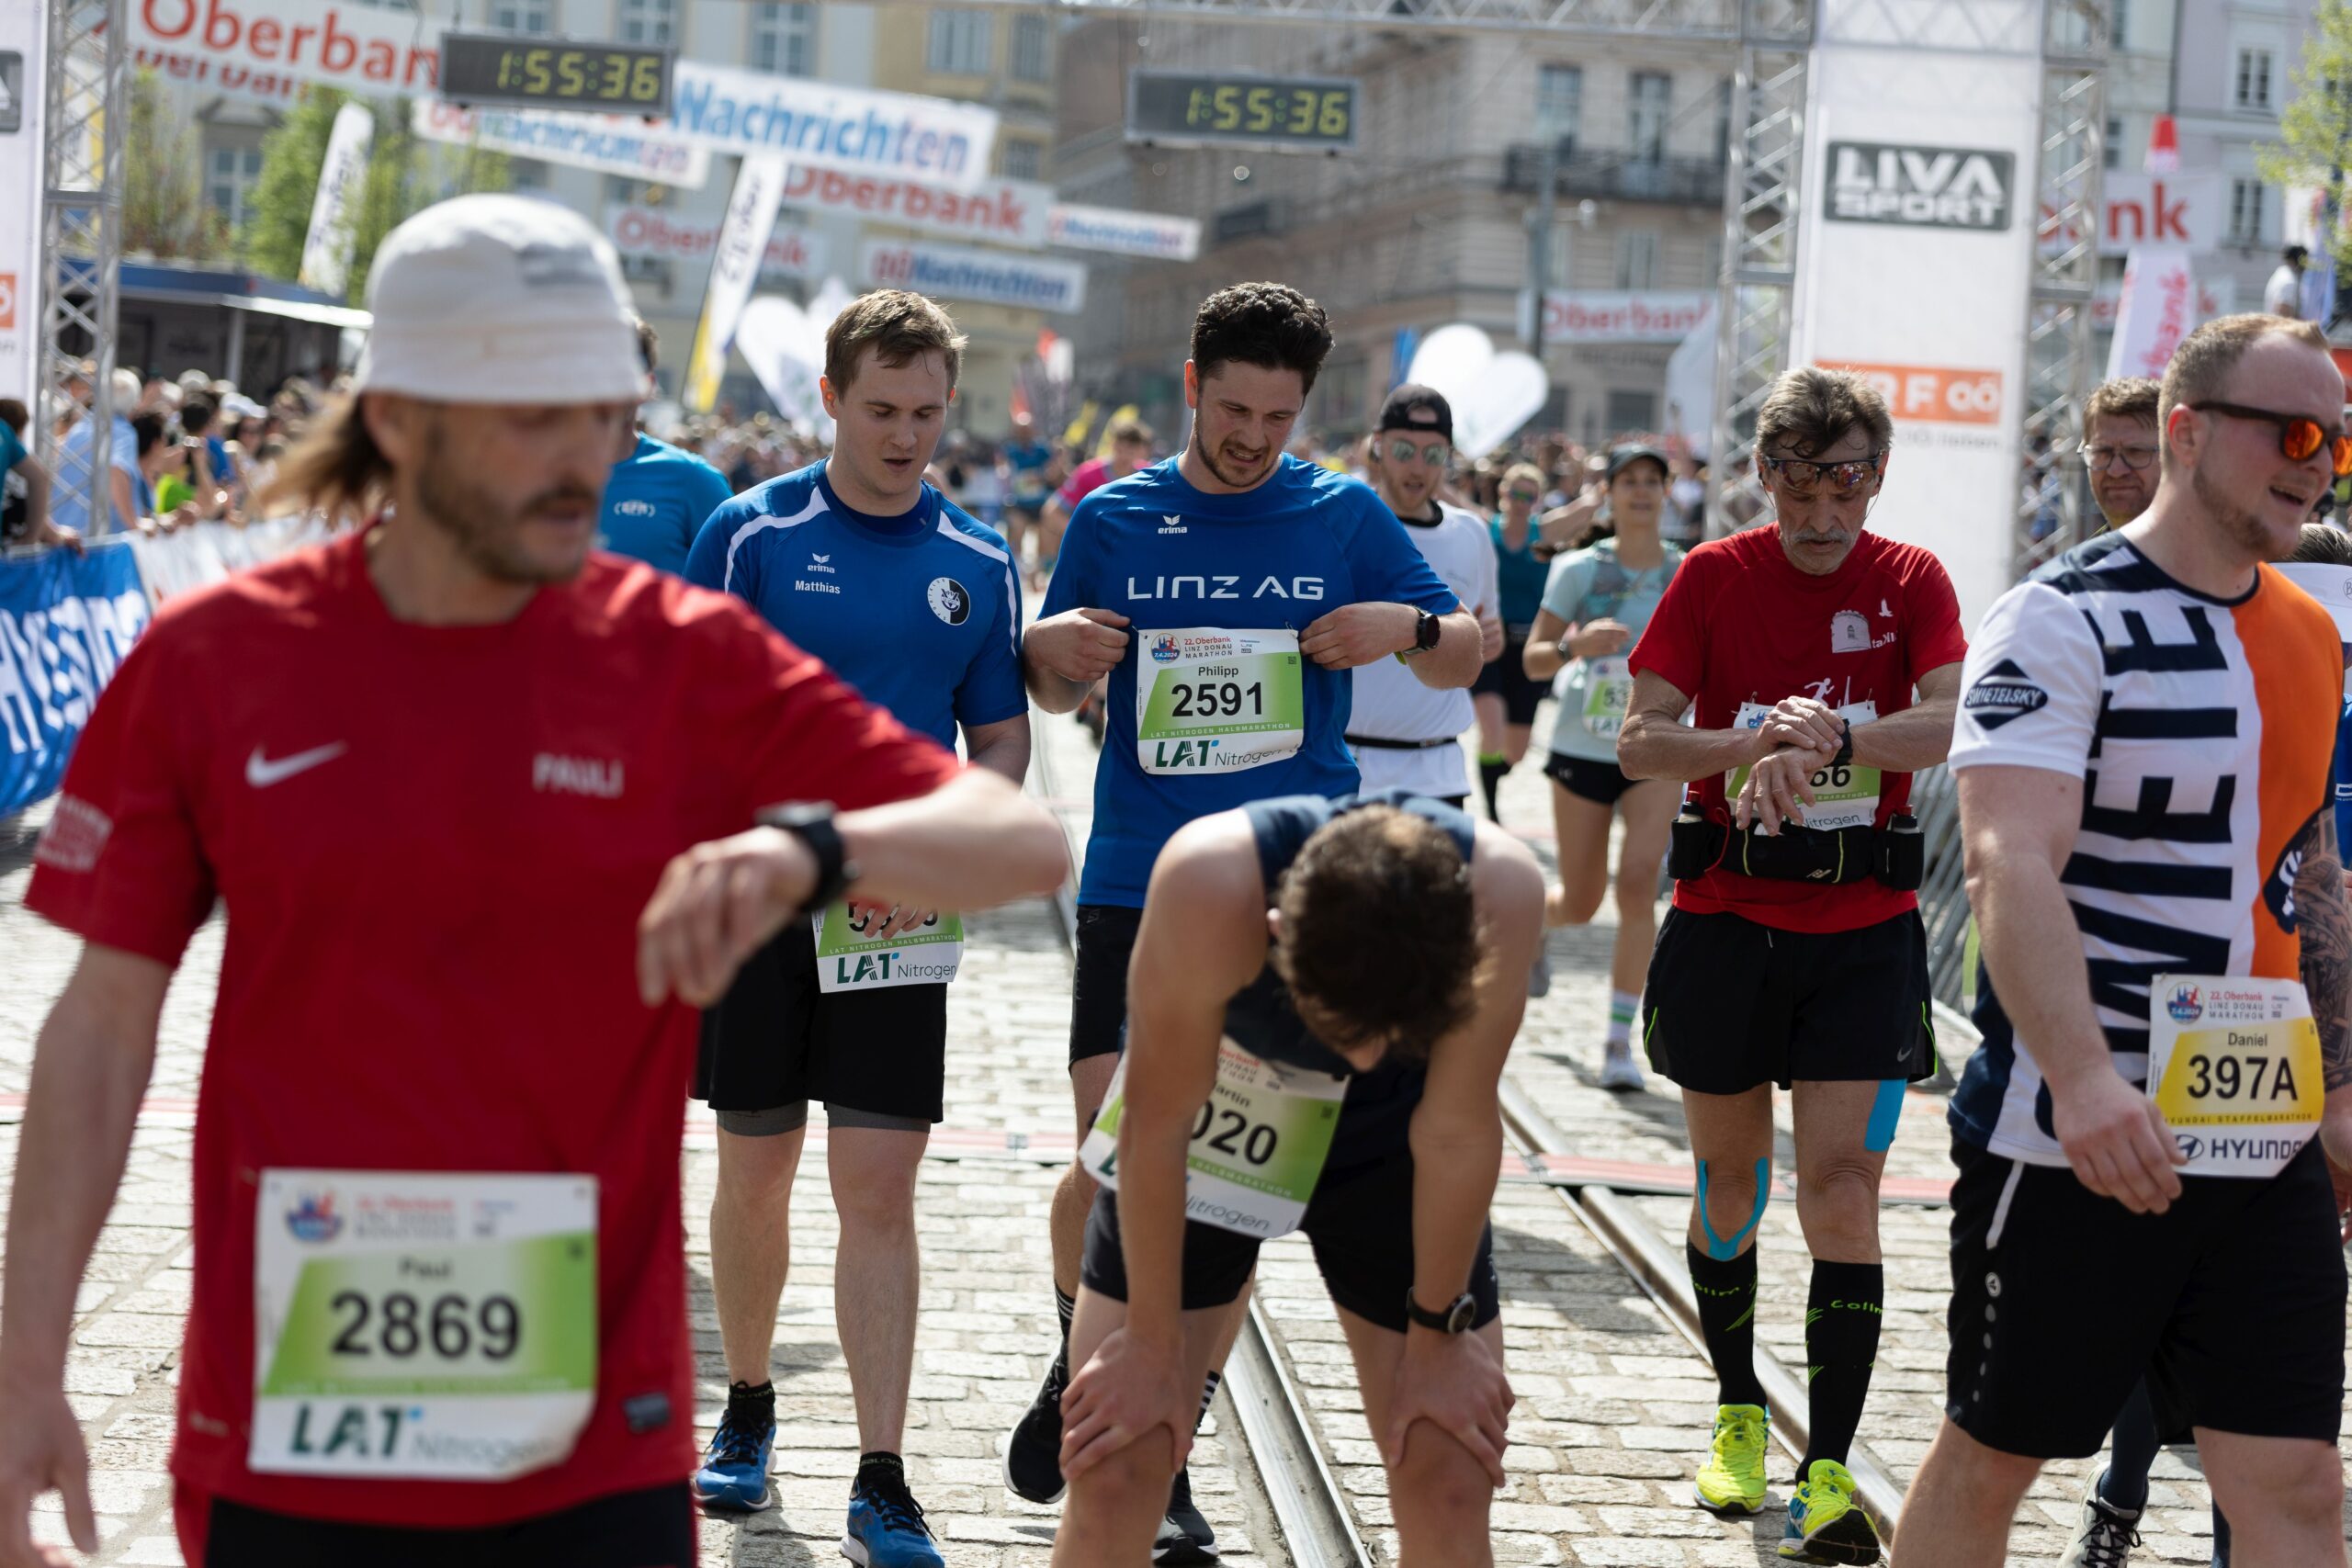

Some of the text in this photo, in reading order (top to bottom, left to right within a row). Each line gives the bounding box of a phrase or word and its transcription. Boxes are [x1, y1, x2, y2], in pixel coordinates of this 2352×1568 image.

[497, 50, 662, 101] 1:55:36
[1186, 85, 1349, 136] 1:55:36
[1836, 146, 2004, 197] LIVA
[1835, 189, 2005, 227] SPORT
[1158, 525, 1187, 535] erima
[808, 564, 835, 574] erima
[795, 580, 841, 594] Matthias
[1127, 576, 1324, 601] LINZ AG
[1195, 636, 1231, 645] Oberbank
[1204, 643, 1232, 651] DONAU
[1185, 650, 1233, 659] MARATHON
[1198, 666, 1239, 678] Philipp
[1170, 682, 1262, 717] 2591
[1966, 686, 2041, 707] SWIETELSKY
[1170, 728, 1215, 737] NITROGEN
[1218, 723, 1291, 733] HALBMARATHON
[1155, 739, 1283, 768] LAT Nitrogen
[849, 942, 893, 952] NITROGEN
[897, 934, 956, 946] HALBMARATHON
[837, 953, 956, 985] LAT Nitrogen
[2210, 990, 2263, 1001] 22. Oberbank
[2209, 1002, 2265, 1010] LINZ DONAU
[2209, 1011, 2264, 1020] MARATHON
[2227, 1032, 2268, 1047] Daniel
[2187, 1054, 2299, 1102] 397A
[330, 1290, 521, 1360] 2869
[288, 1403, 403, 1459] LAT
